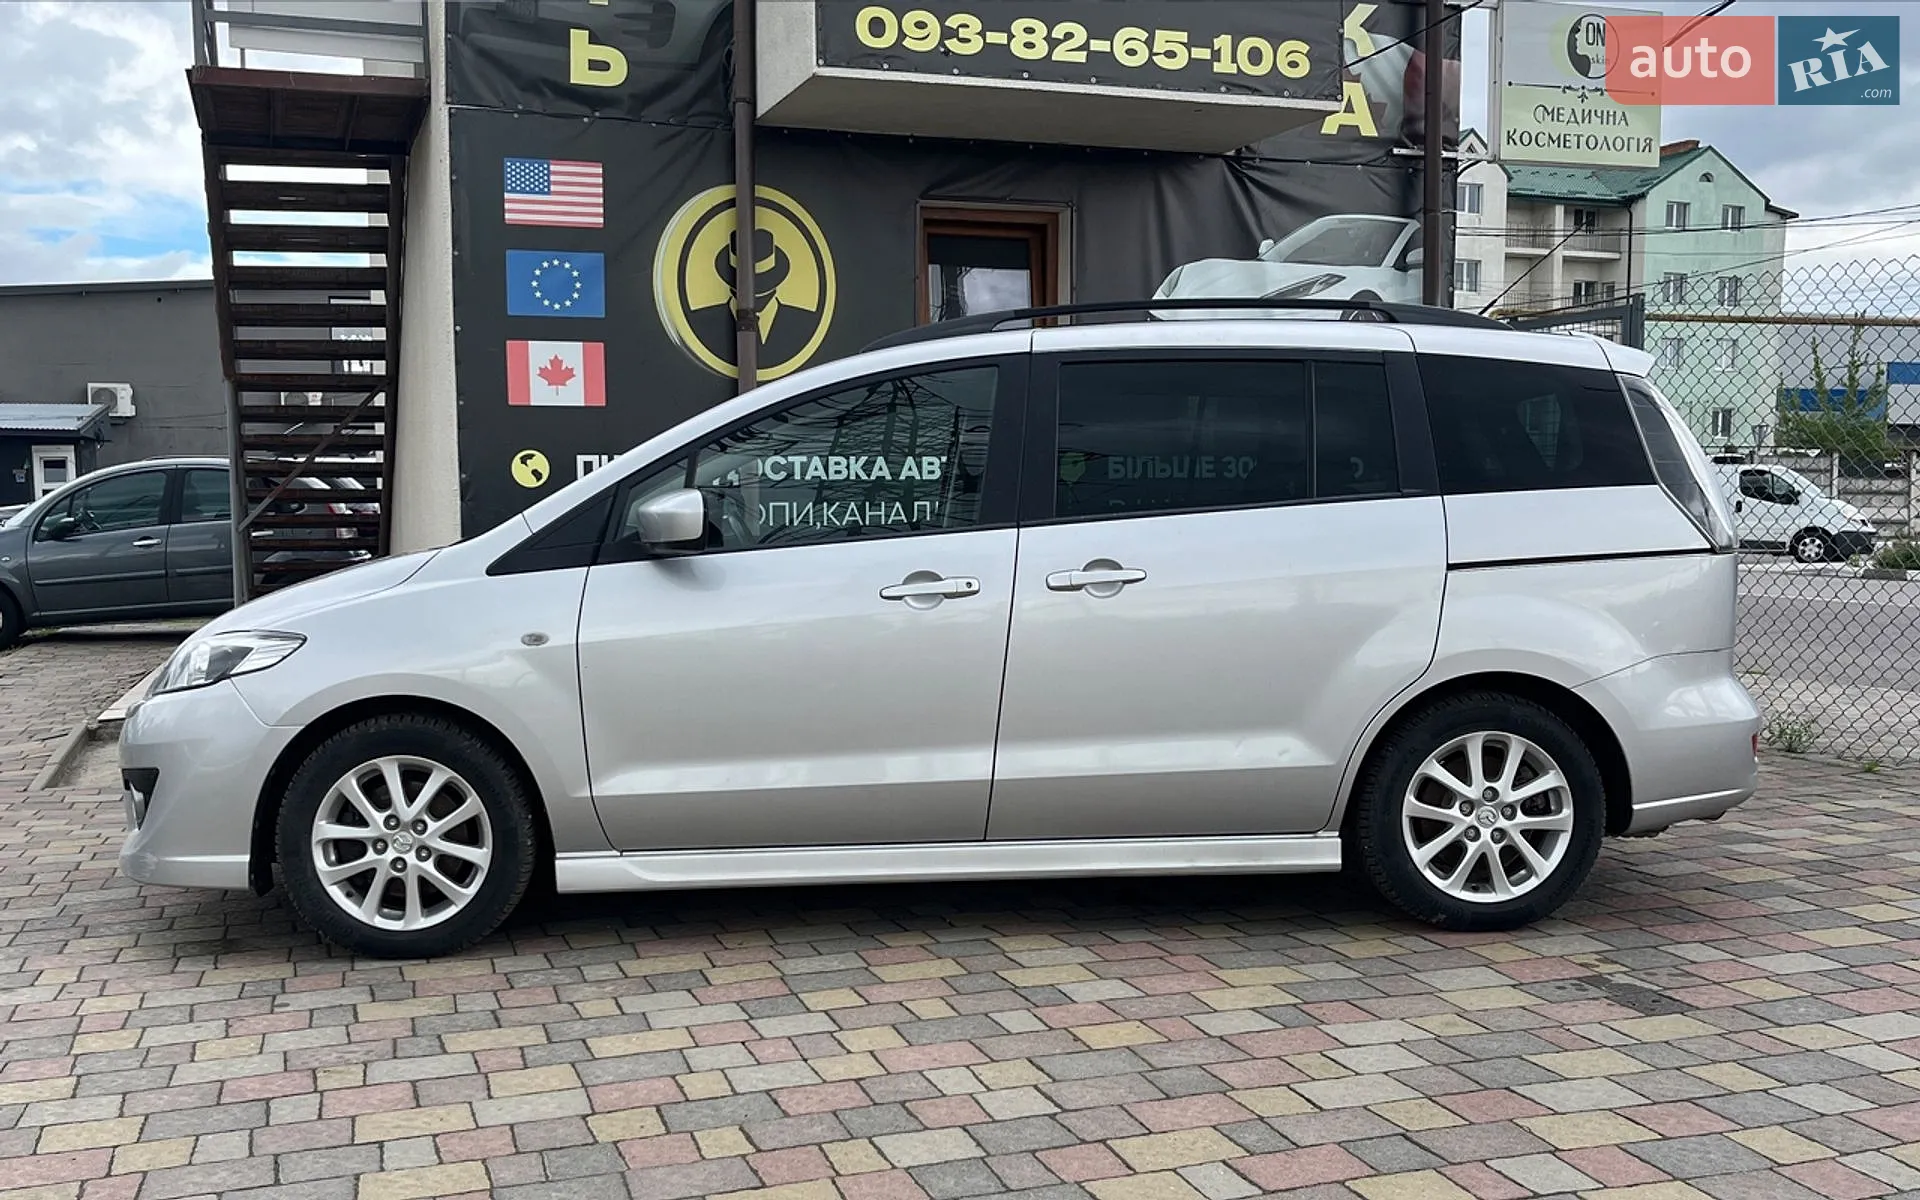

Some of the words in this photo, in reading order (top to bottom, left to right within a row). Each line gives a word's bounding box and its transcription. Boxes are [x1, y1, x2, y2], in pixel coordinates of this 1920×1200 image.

[570, 0, 628, 87] Ь
[855, 6, 1311, 79] 093-82-65-106
[1586, 22, 1606, 47] ON
[1533, 104, 1629, 127] МЕДИЧНА
[1506, 128, 1653, 153] КОСМЕТОЛОГІЯ
[899, 455, 947, 480] АВ
